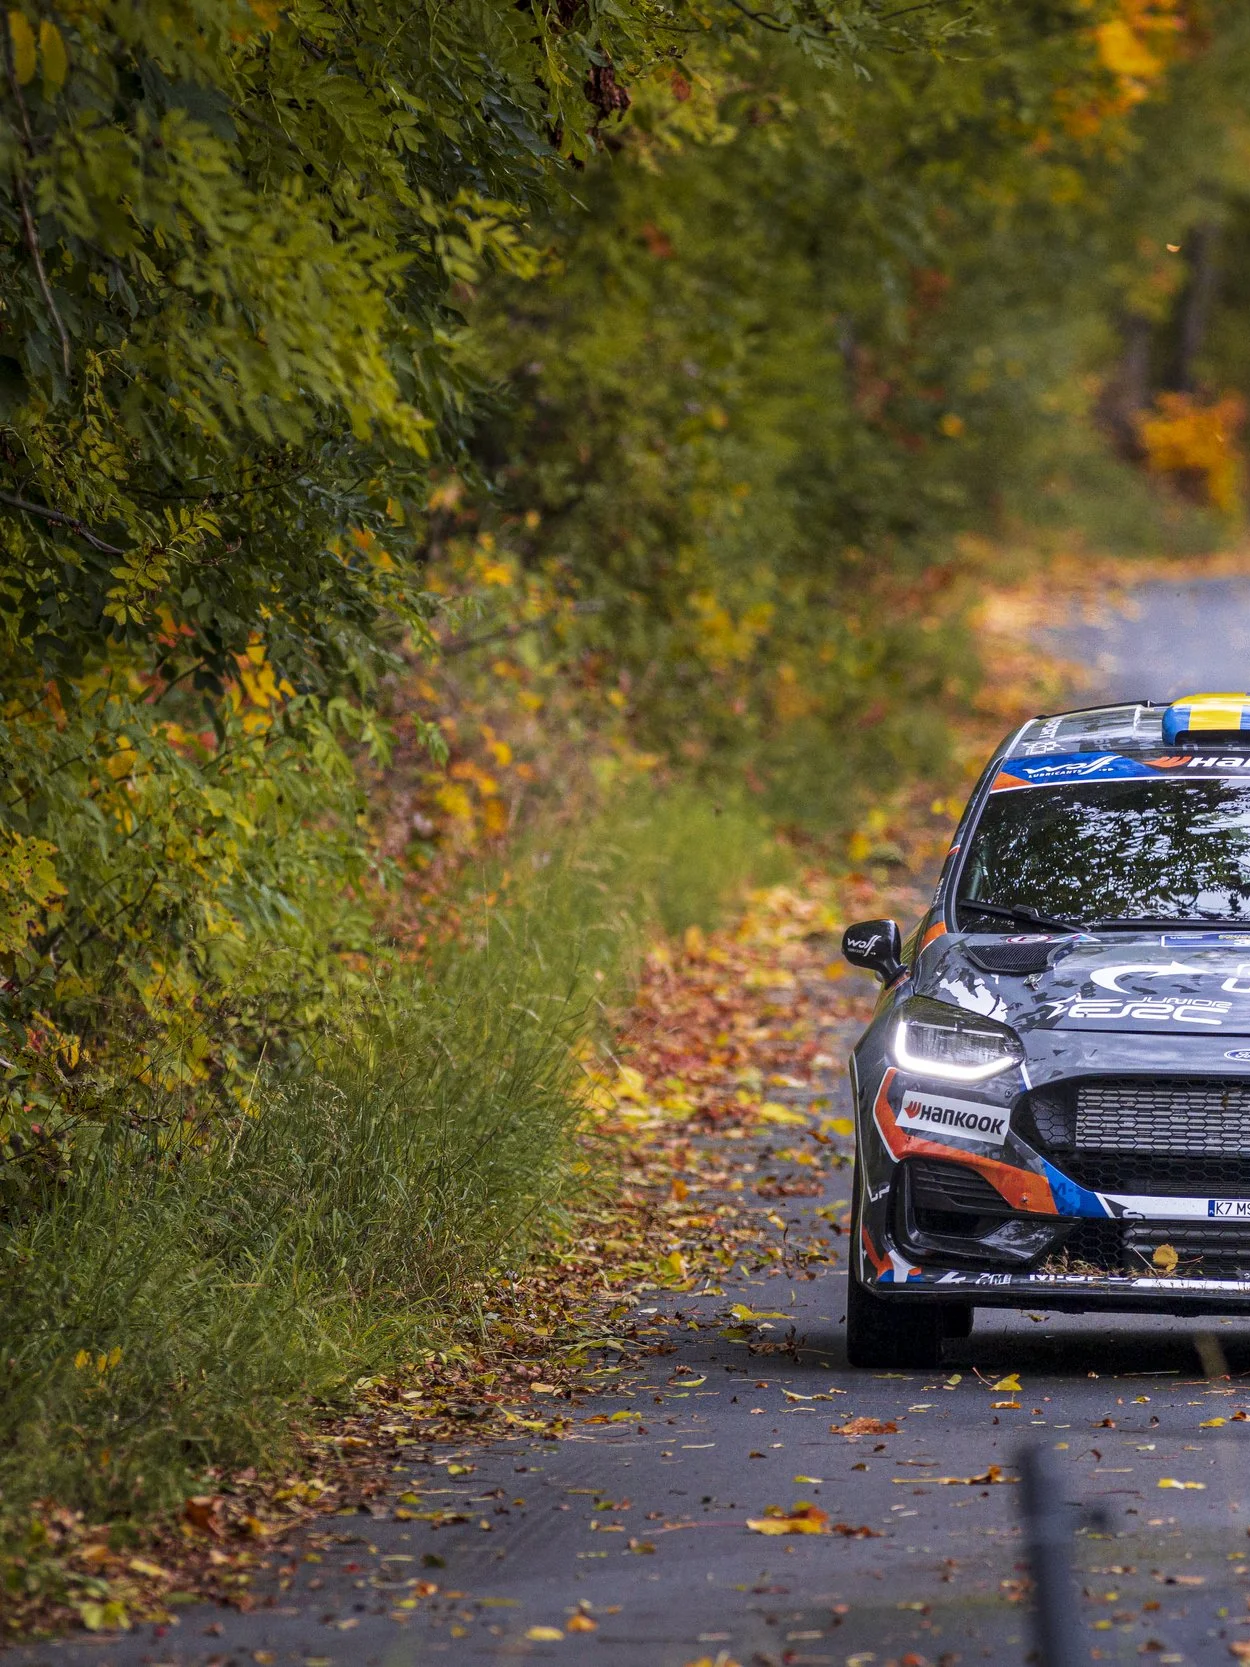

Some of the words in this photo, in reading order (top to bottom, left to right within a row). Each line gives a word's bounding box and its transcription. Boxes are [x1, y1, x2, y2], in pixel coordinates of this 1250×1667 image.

[1028, 769, 1083, 779] LUBRICANTS
[1126, 996, 1233, 1008] JUNIOR
[1068, 1002, 1231, 1025] ERC
[918, 1104, 1006, 1136] HANKOOK
[1215, 1202, 1232, 1216] K7
